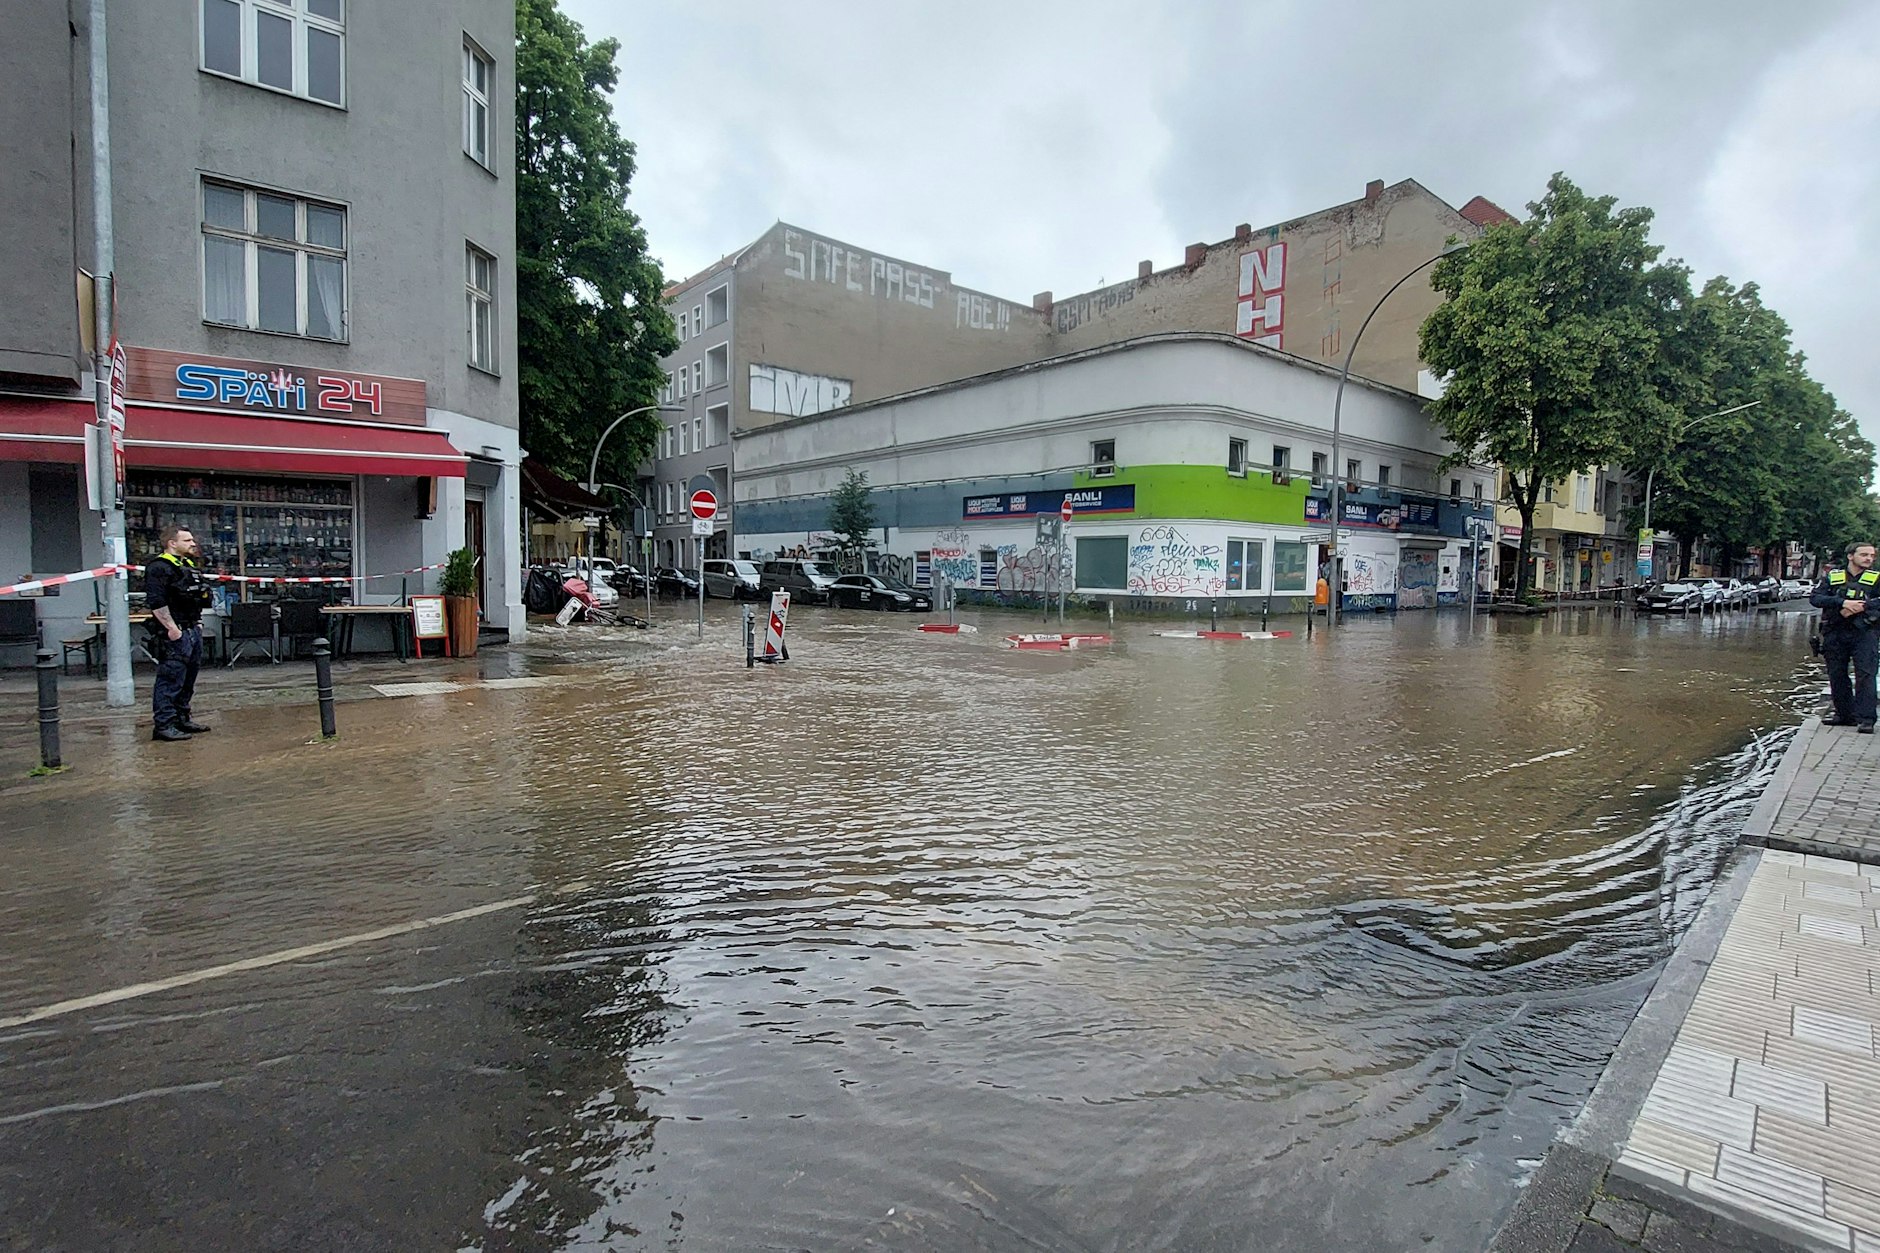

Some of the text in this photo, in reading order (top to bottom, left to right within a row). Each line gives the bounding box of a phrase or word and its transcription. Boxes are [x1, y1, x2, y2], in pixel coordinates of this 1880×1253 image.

[317, 376, 382, 415] 24
[1010, 496, 1026, 504] LIQUI
[1064, 491, 1102, 502] SANLI
[1010, 503, 1026, 511] MOLY
[1345, 505, 1368, 515] SANLI
